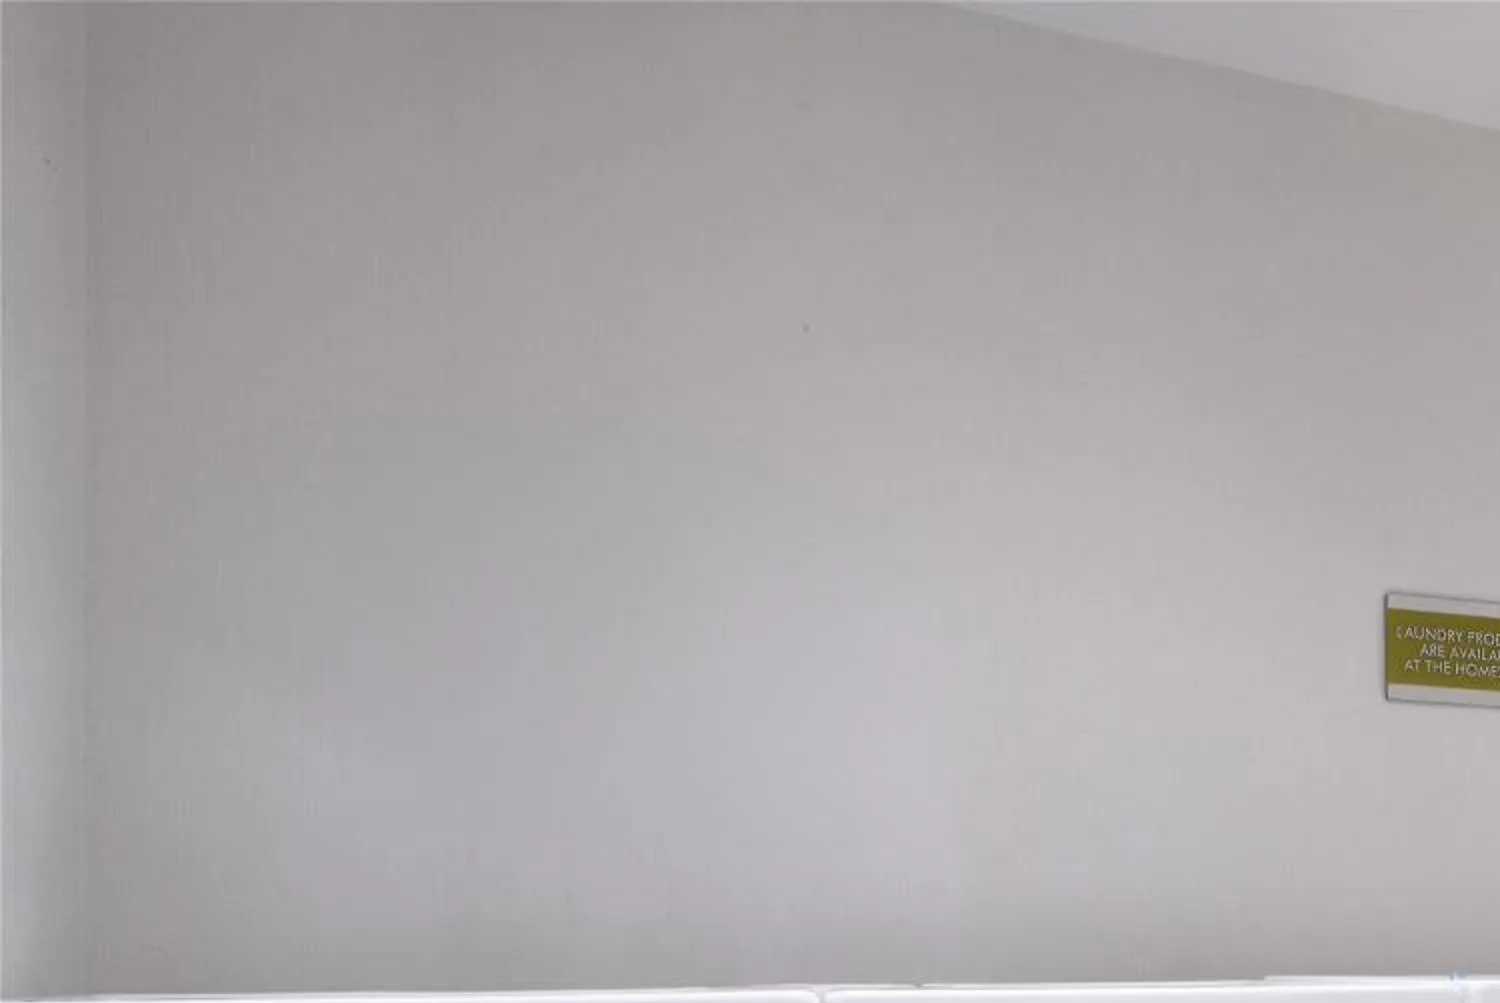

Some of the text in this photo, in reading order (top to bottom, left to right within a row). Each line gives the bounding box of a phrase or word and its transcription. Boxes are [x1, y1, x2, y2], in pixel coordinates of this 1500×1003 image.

[1396, 626, 1464, 643] LAUNDRY
[1420, 644, 1445, 658] ARE
[1404, 660, 1421, 672] AT
[1425, 660, 1450, 675] THE
